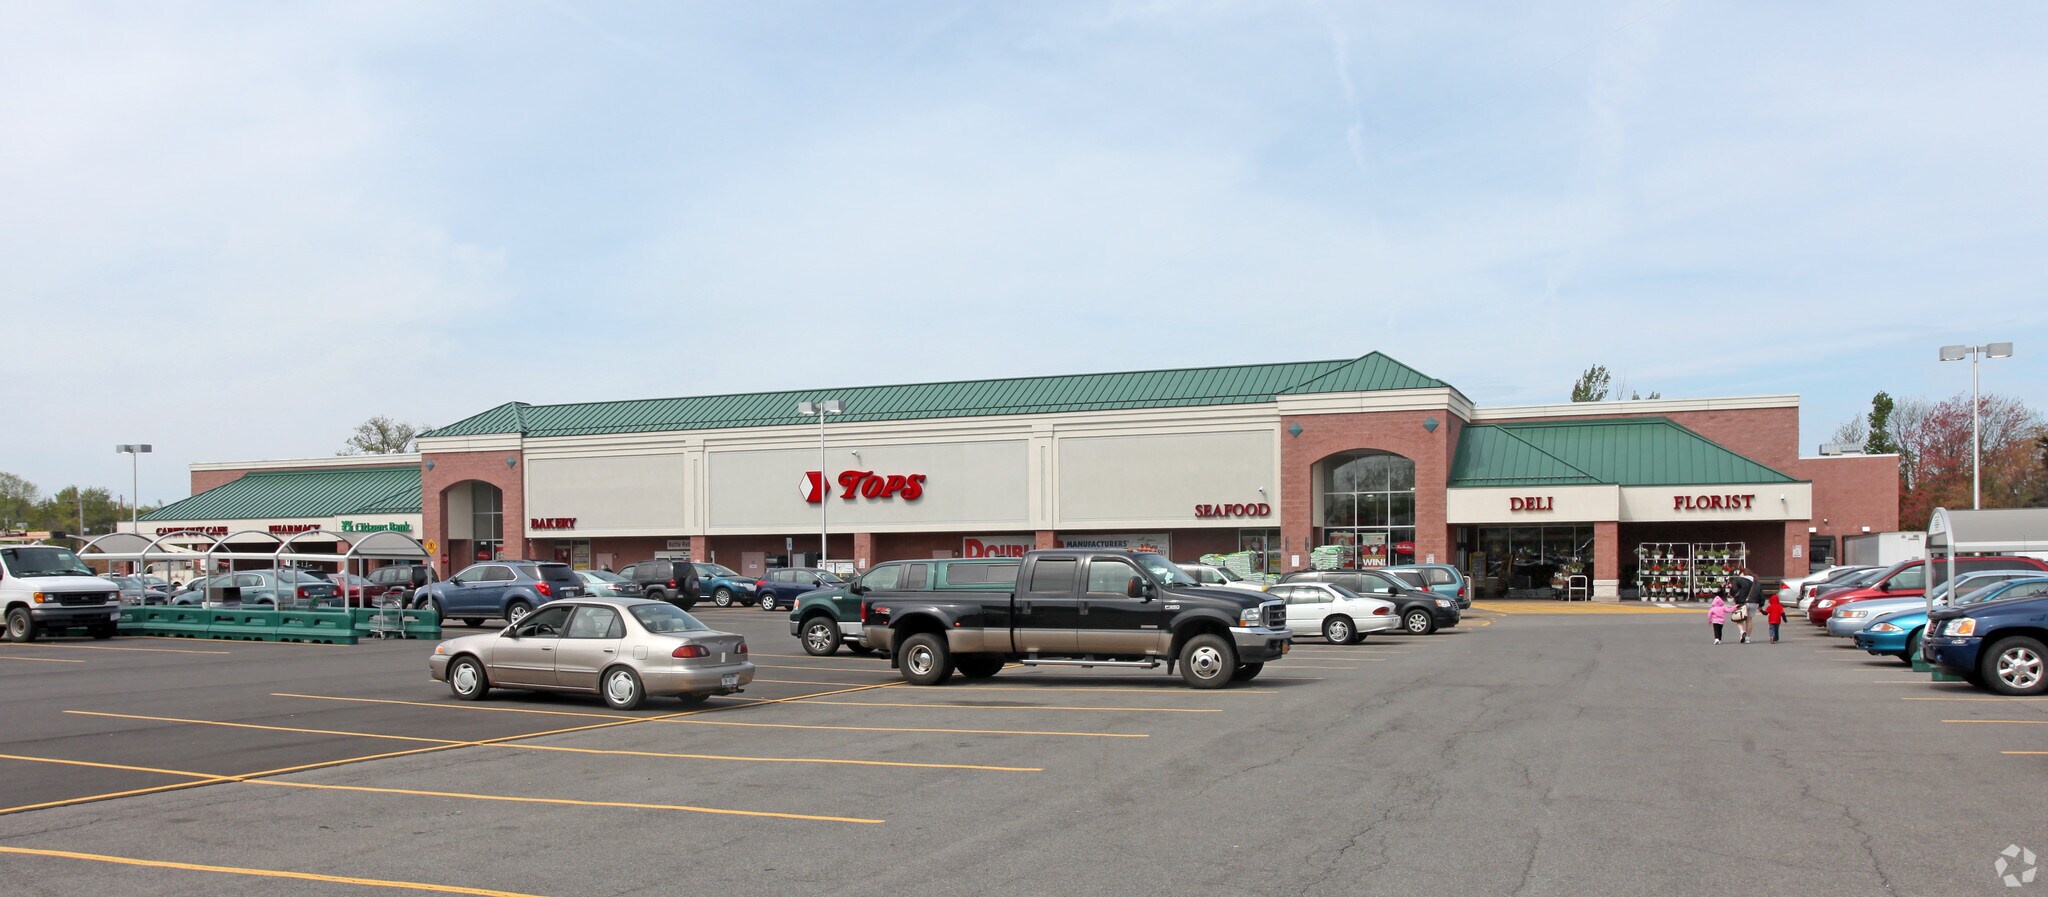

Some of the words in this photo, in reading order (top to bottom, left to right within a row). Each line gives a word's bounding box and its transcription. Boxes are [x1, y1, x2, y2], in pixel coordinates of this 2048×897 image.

[838, 470, 927, 501] TOPS
[1509, 496, 1554, 511] DELI
[1673, 494, 1755, 510] FLORIST
[1194, 503, 1271, 518] SEAFOOD
[268, 524, 321, 534] PHARMACY
[355, 522, 388, 532] Citizens
[388, 521, 411, 532] Bank
[530, 518, 577, 529] BAKERY
[1362, 558, 1386, 566] WIN!
